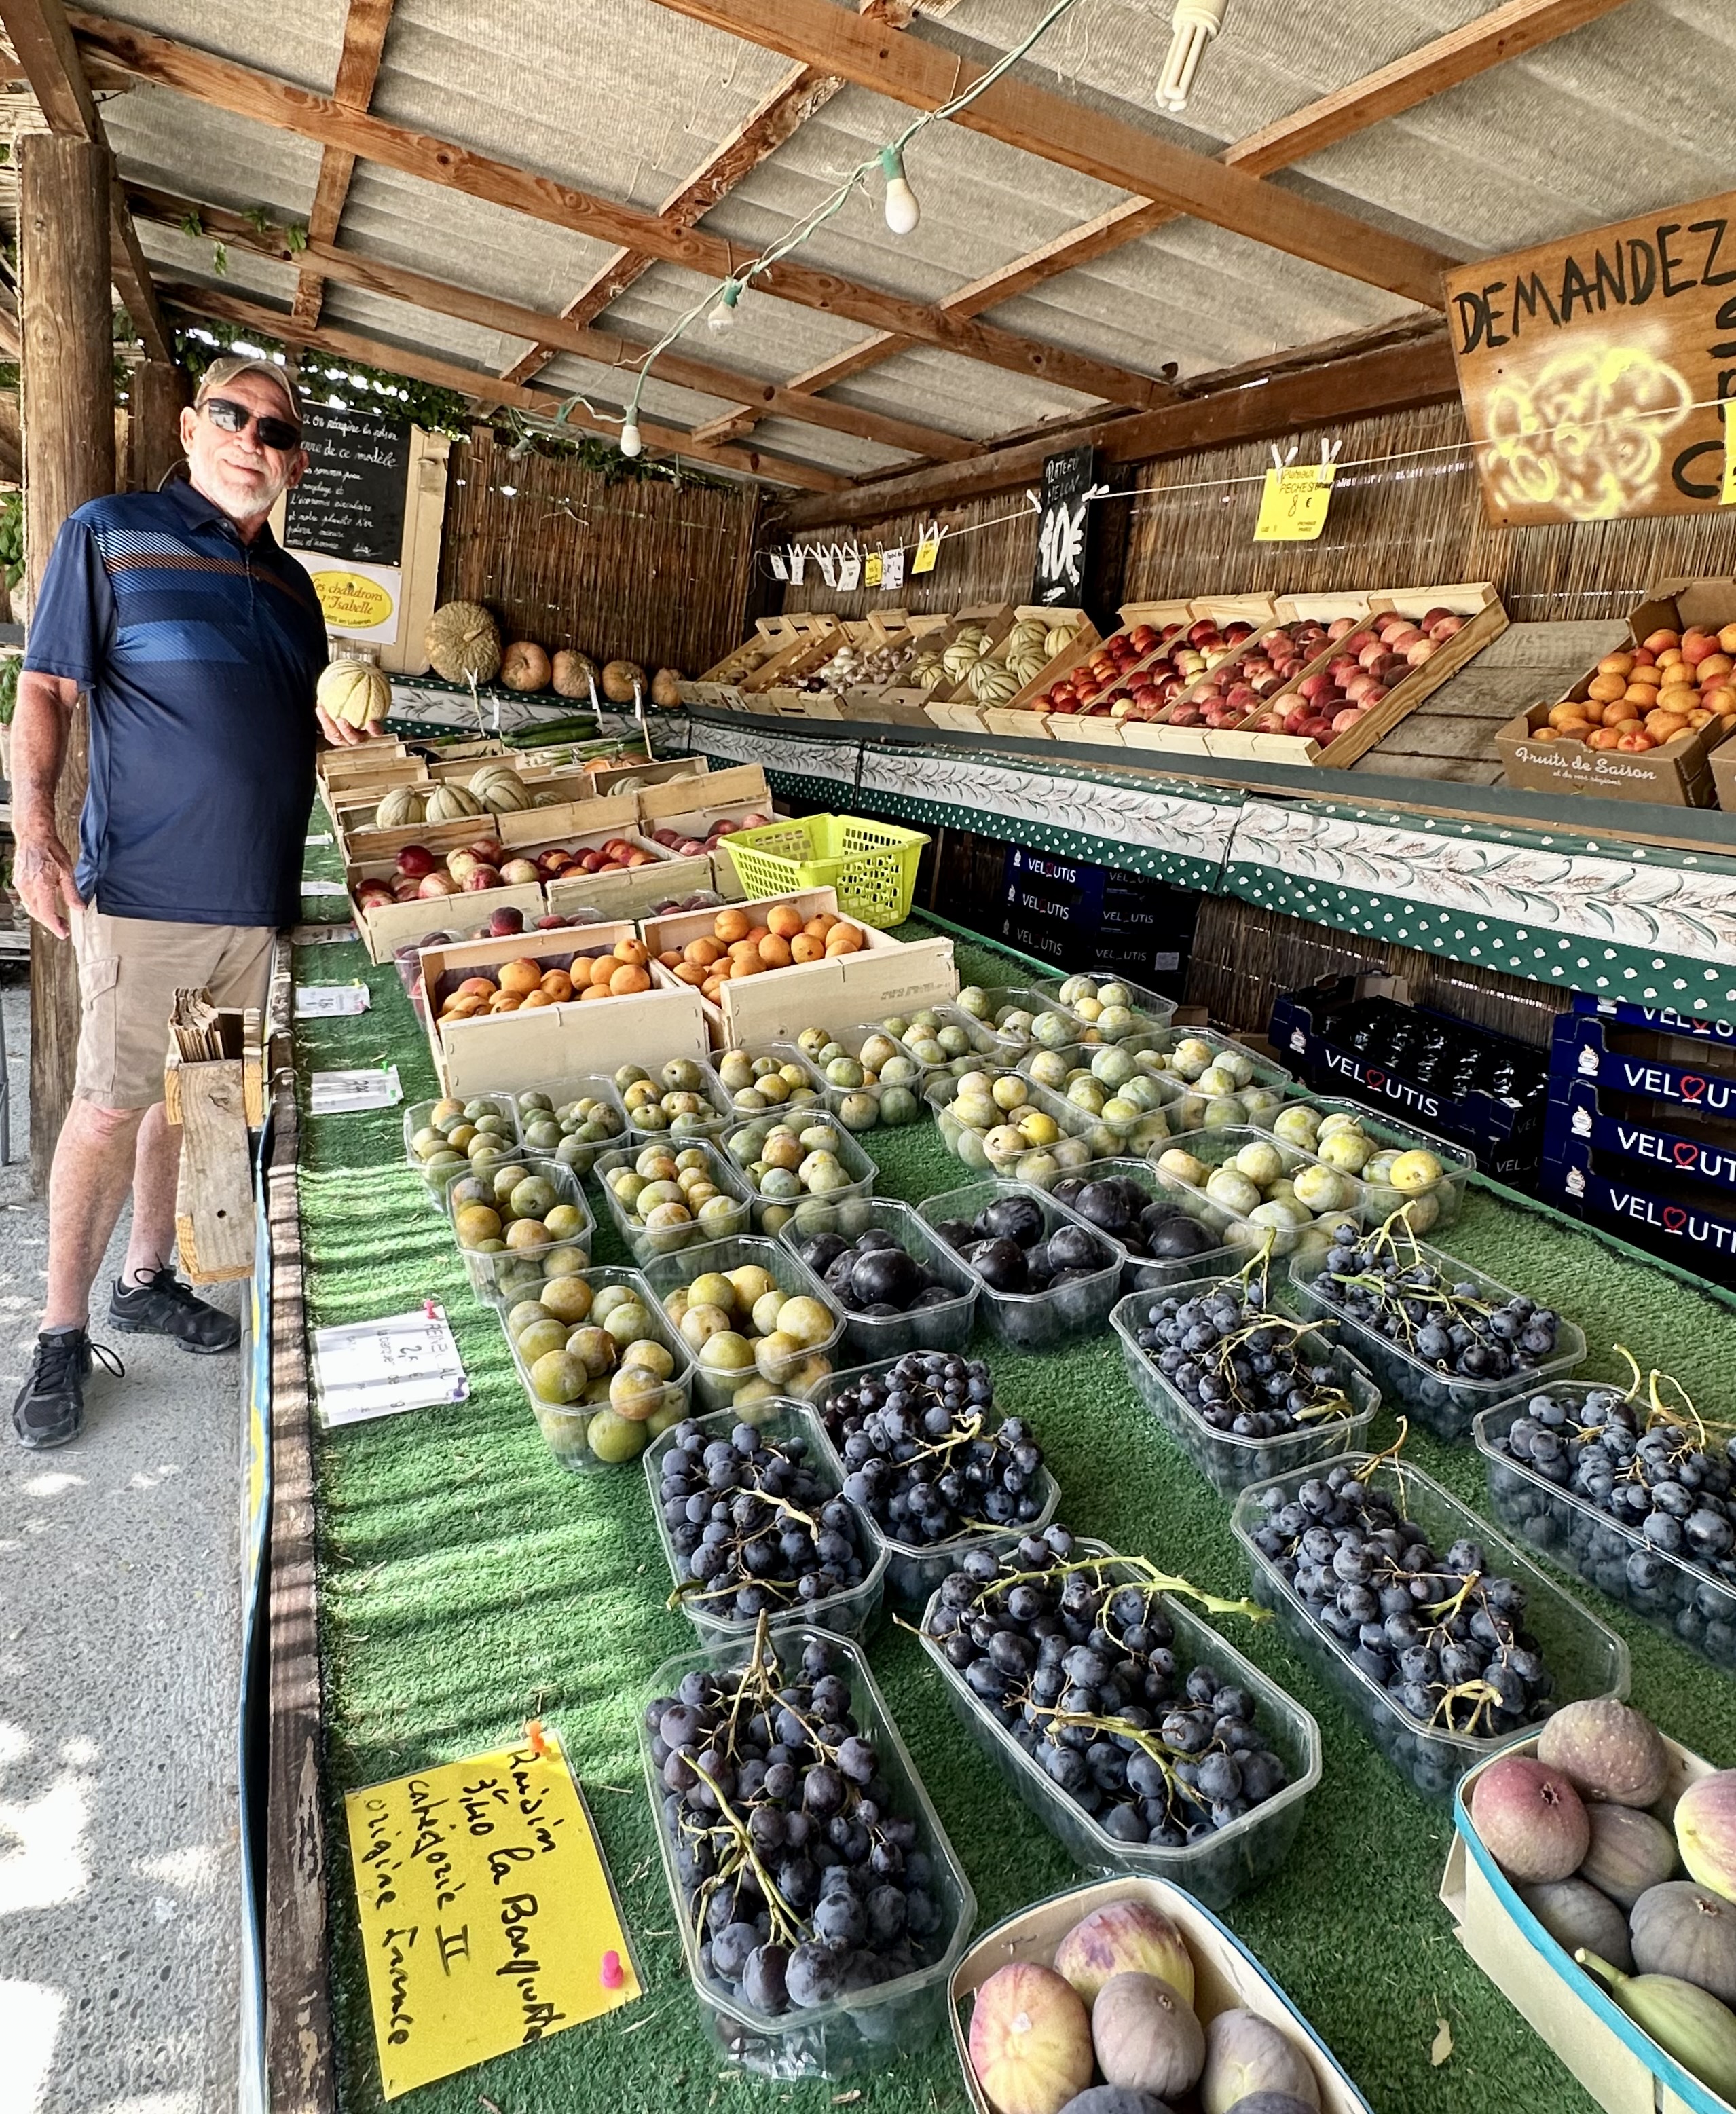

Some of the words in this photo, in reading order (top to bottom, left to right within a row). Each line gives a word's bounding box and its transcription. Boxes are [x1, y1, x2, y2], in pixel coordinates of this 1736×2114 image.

[1452, 219, 1736, 354] DEMANDEZ
[323, 438, 337, 457] de
[339, 448, 351, 459] ce
[354, 446, 399, 468] modèle
[1046, 473, 1080, 504] MELON
[1287, 494, 1298, 517] 8
[1515, 747, 1569, 768] Fruits
[1571, 754, 1592, 771] de
[1595, 758, 1657, 780] Saison
[1028, 857, 1077, 883] VELOUTIS
[1103, 910, 1154, 924] VELUTIS
[1017, 927, 1063, 956] VELUTIS
[1096, 948, 1147, 961] VELUTIS
[1325, 1048, 1439, 1117] VELOUTIS
[1623, 1063, 1736, 1109] VELOU
[507, 1749, 564, 1853] Raisin
[361, 1798, 403, 1910] origine
[487, 1847, 536, 1886] la
[381, 1925, 419, 2045] France
